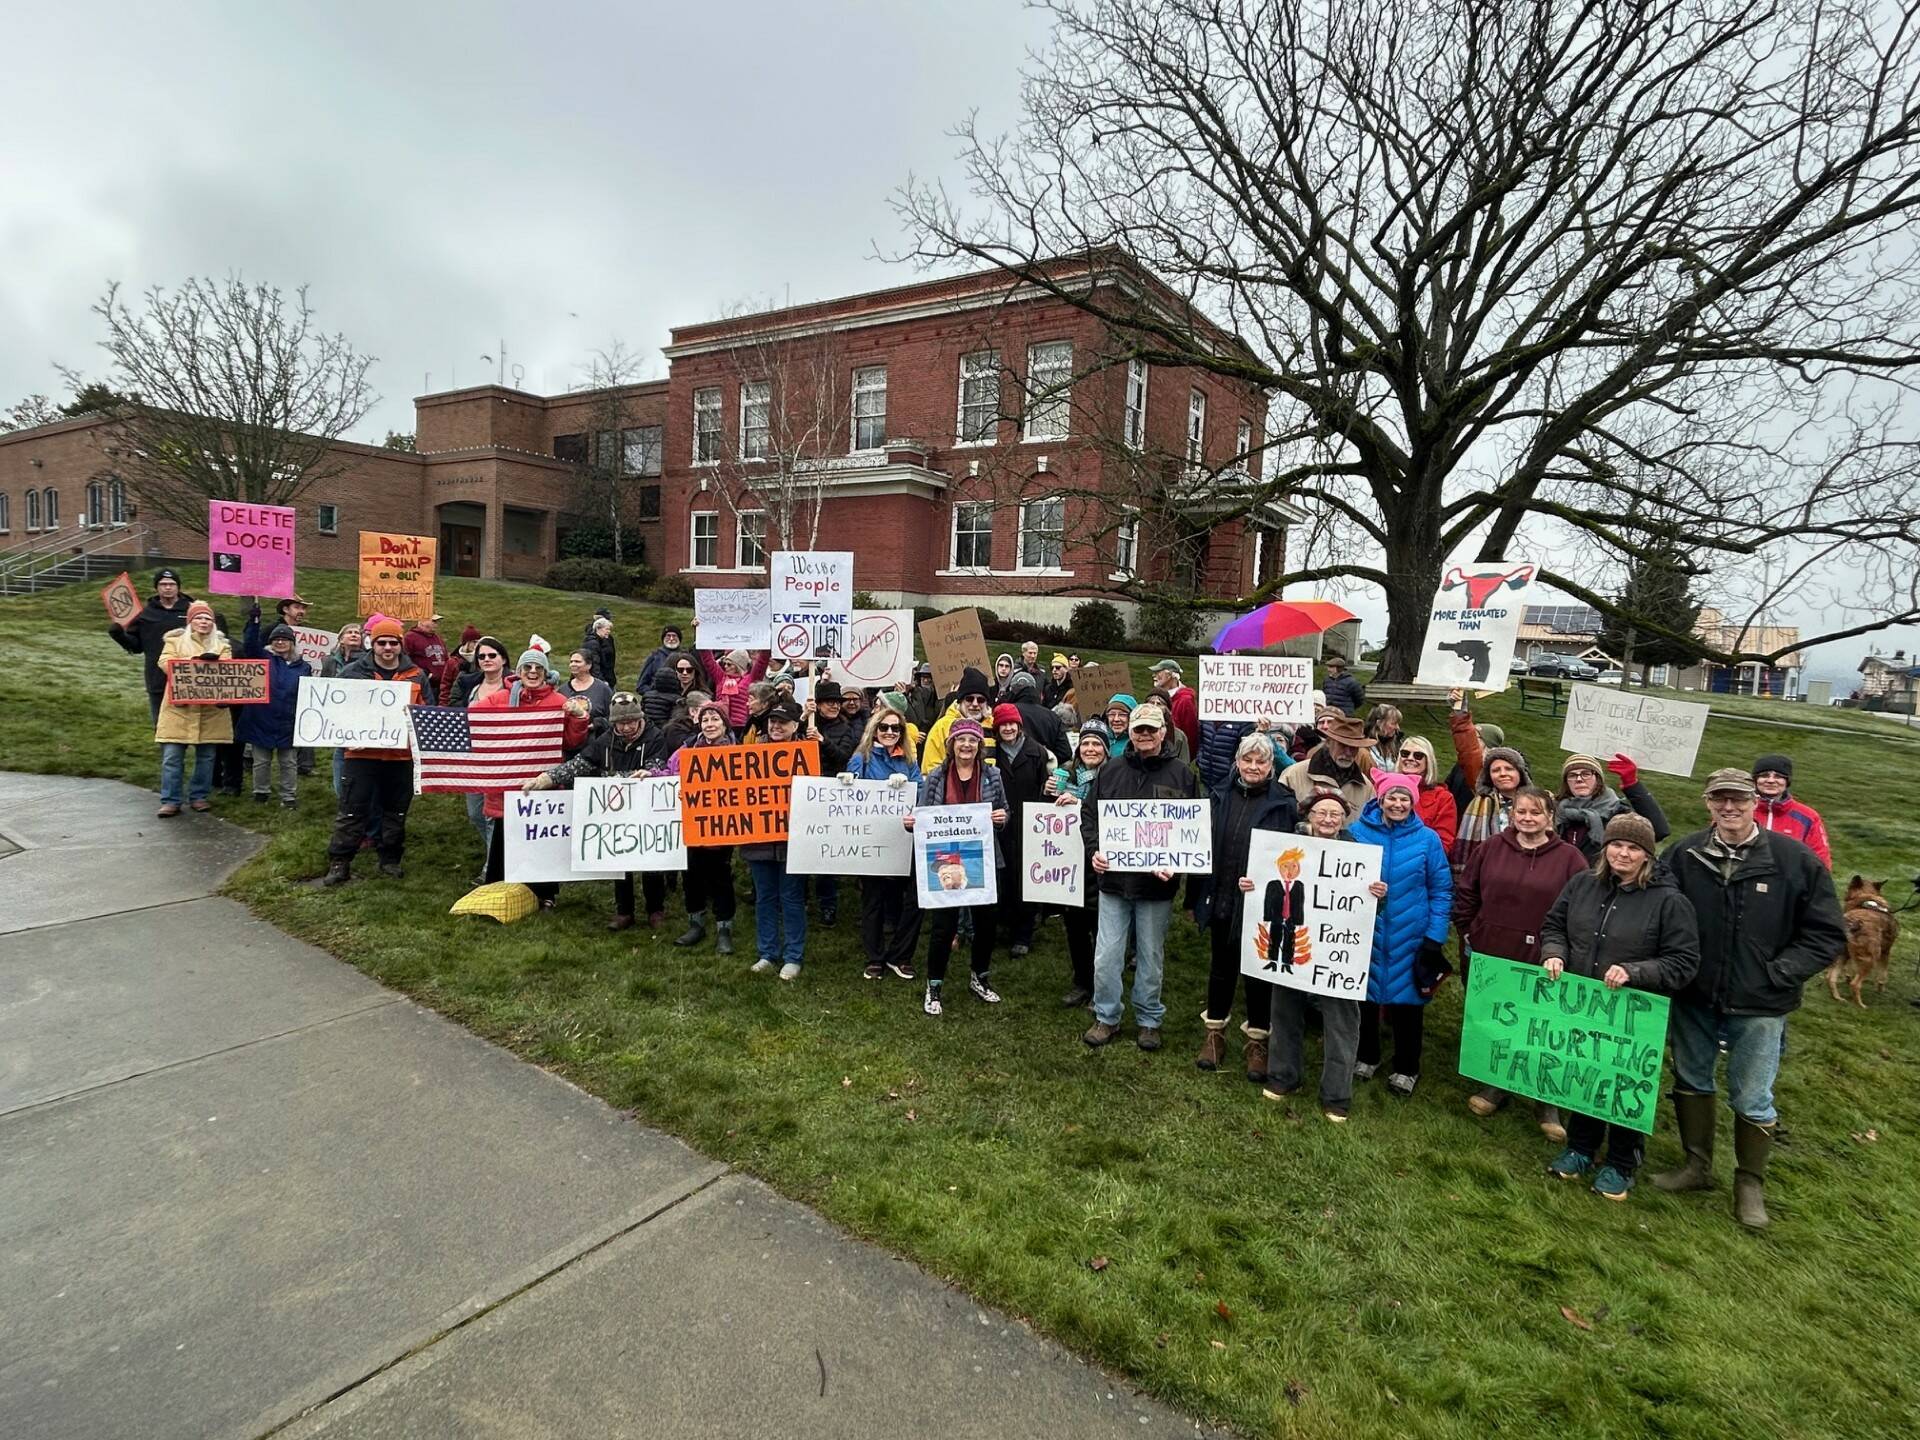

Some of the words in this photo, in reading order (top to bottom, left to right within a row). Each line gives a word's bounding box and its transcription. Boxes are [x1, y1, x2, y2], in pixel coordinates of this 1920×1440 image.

[221, 507, 293, 528] DELETE
[227, 532, 291, 555] DOGE!
[363, 556, 431, 569] TRUMP
[791, 555, 812, 574] We
[785, 576, 840, 597] People
[773, 613, 848, 624] EVERYONE
[1433, 609, 1457, 620] MORE
[1461, 608, 1507, 620] REGULATED
[1458, 620, 1481, 630] THAN
[293, 631, 329, 646] TAND
[302, 649, 325, 659] FOR
[172, 663, 190, 674] HE
[219, 664, 265, 676] BETRAYS
[1228, 663, 1254, 676] THE
[176, 675, 192, 685] HIS
[195, 676, 253, 687] COUNTRY
[1201, 680, 1247, 693] PROTEST
[1262, 682, 1309, 695] PROTECT
[299, 708, 401, 746] Oligarchy
[1573, 712, 1594, 730] WE
[1604, 722, 1633, 737] HAVE
[687, 748, 809, 783] AMERICA
[589, 782, 637, 815] NOT
[651, 781, 679, 808] MY
[685, 788, 739, 808] WE'RE
[746, 784, 791, 806] BETT
[807, 786, 872, 802] DESTROY
[877, 790, 906, 802] THE
[828, 804, 914, 817] PATRIARCHY
[1103, 802, 1147, 818] MUSK
[1150, 803, 1158, 818] &
[1160, 803, 1201, 820] TRUMP
[695, 813, 753, 837] THAN
[759, 810, 789, 833] TH
[806, 824, 832, 835] NOT
[843, 824, 872, 835] THE
[933, 816, 953, 825] Not
[955, 816, 972, 825] my
[1033, 813, 1078, 836] STOP
[525, 824, 571, 840] HACK
[582, 821, 683, 860] PRESIDENT
[926, 827, 981, 839] president.
[1105, 827, 1130, 842] ARE
[1135, 821, 1173, 848] NOT
[1181, 828, 1200, 844] MY
[821, 844, 888, 858] PLANET
[1042, 839, 1064, 857] the
[1106, 850, 1211, 868] PRESIDENTS!
[1318, 923, 1360, 945] Pants
[1329, 950, 1349, 963] on
[1311, 964, 1366, 990] Fire!
[1510, 966, 1652, 1036] TRUMP
[1491, 1001, 1519, 1027] IS
[1526, 1017, 1659, 1078] HURTING
[1489, 1038, 1653, 1120] FARMERS
